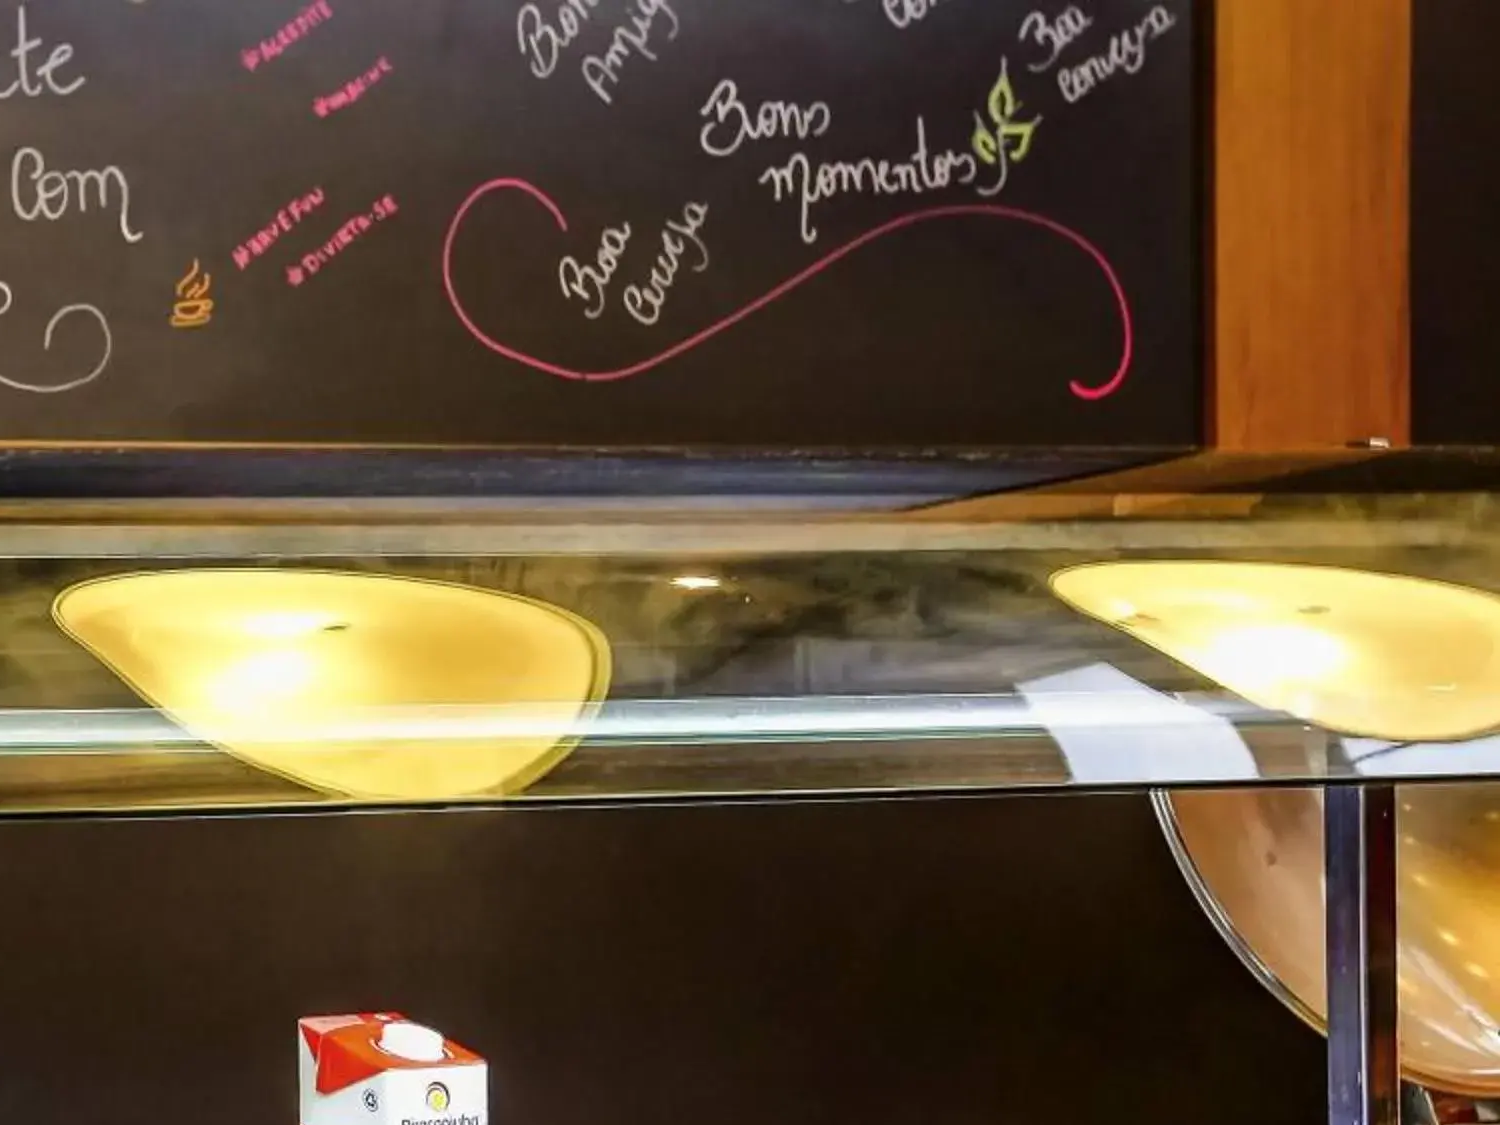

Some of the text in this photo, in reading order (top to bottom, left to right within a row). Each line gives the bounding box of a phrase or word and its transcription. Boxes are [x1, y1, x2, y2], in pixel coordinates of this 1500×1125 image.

[700, 79, 831, 157] Bons
[11, 146, 143, 243] Com
[558, 220, 632, 320] Boa
